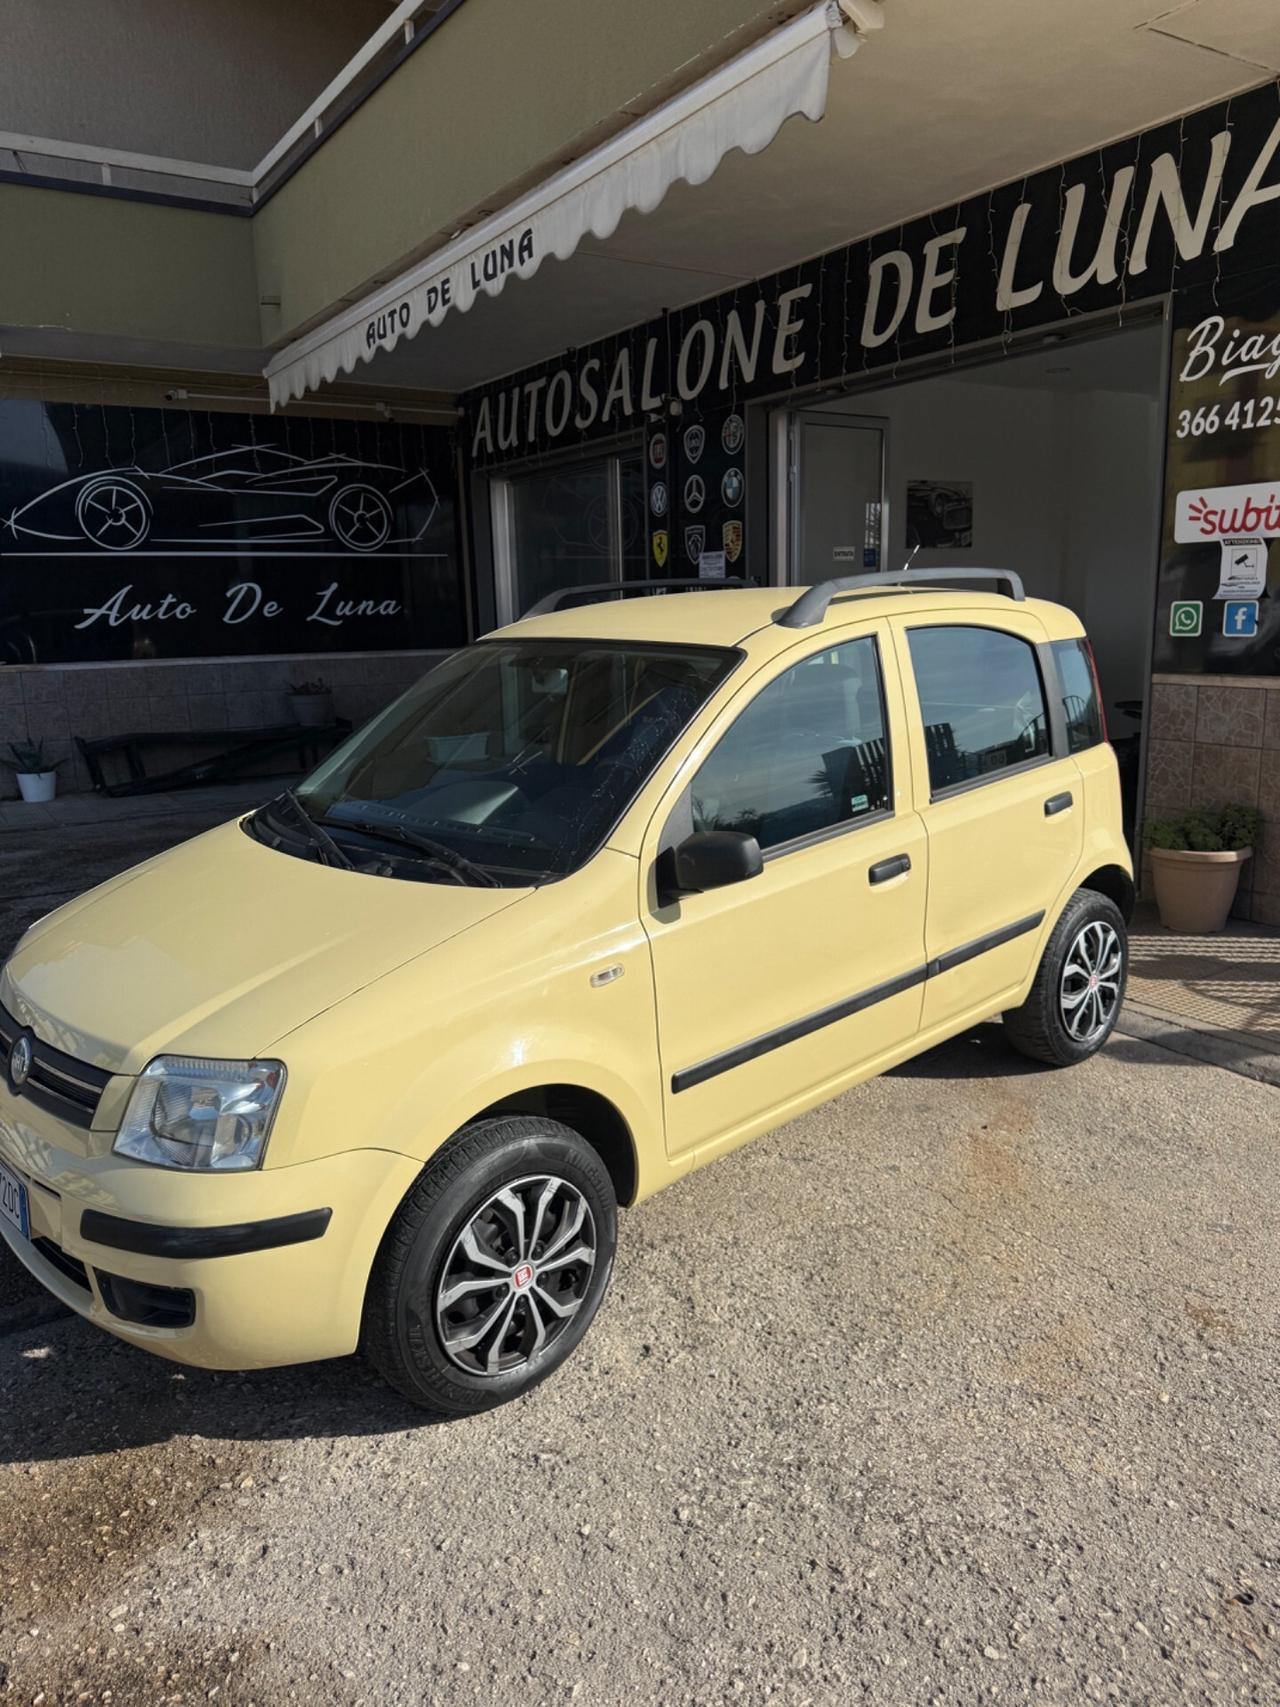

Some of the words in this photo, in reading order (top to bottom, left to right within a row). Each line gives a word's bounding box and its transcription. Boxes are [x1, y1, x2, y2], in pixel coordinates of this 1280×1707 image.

[366, 302, 410, 349] AUTO
[427, 277, 451, 314] DE
[470, 228, 533, 290] LUNA
[472, 283, 812, 458] AUTOSALONE
[861, 226, 967, 348] DE
[1176, 404, 1220, 438] 366
[75, 584, 197, 629] Auto
[223, 582, 283, 625] De
[306, 582, 401, 626] Luna
[0, 1172, 20, 1219] 2DC
